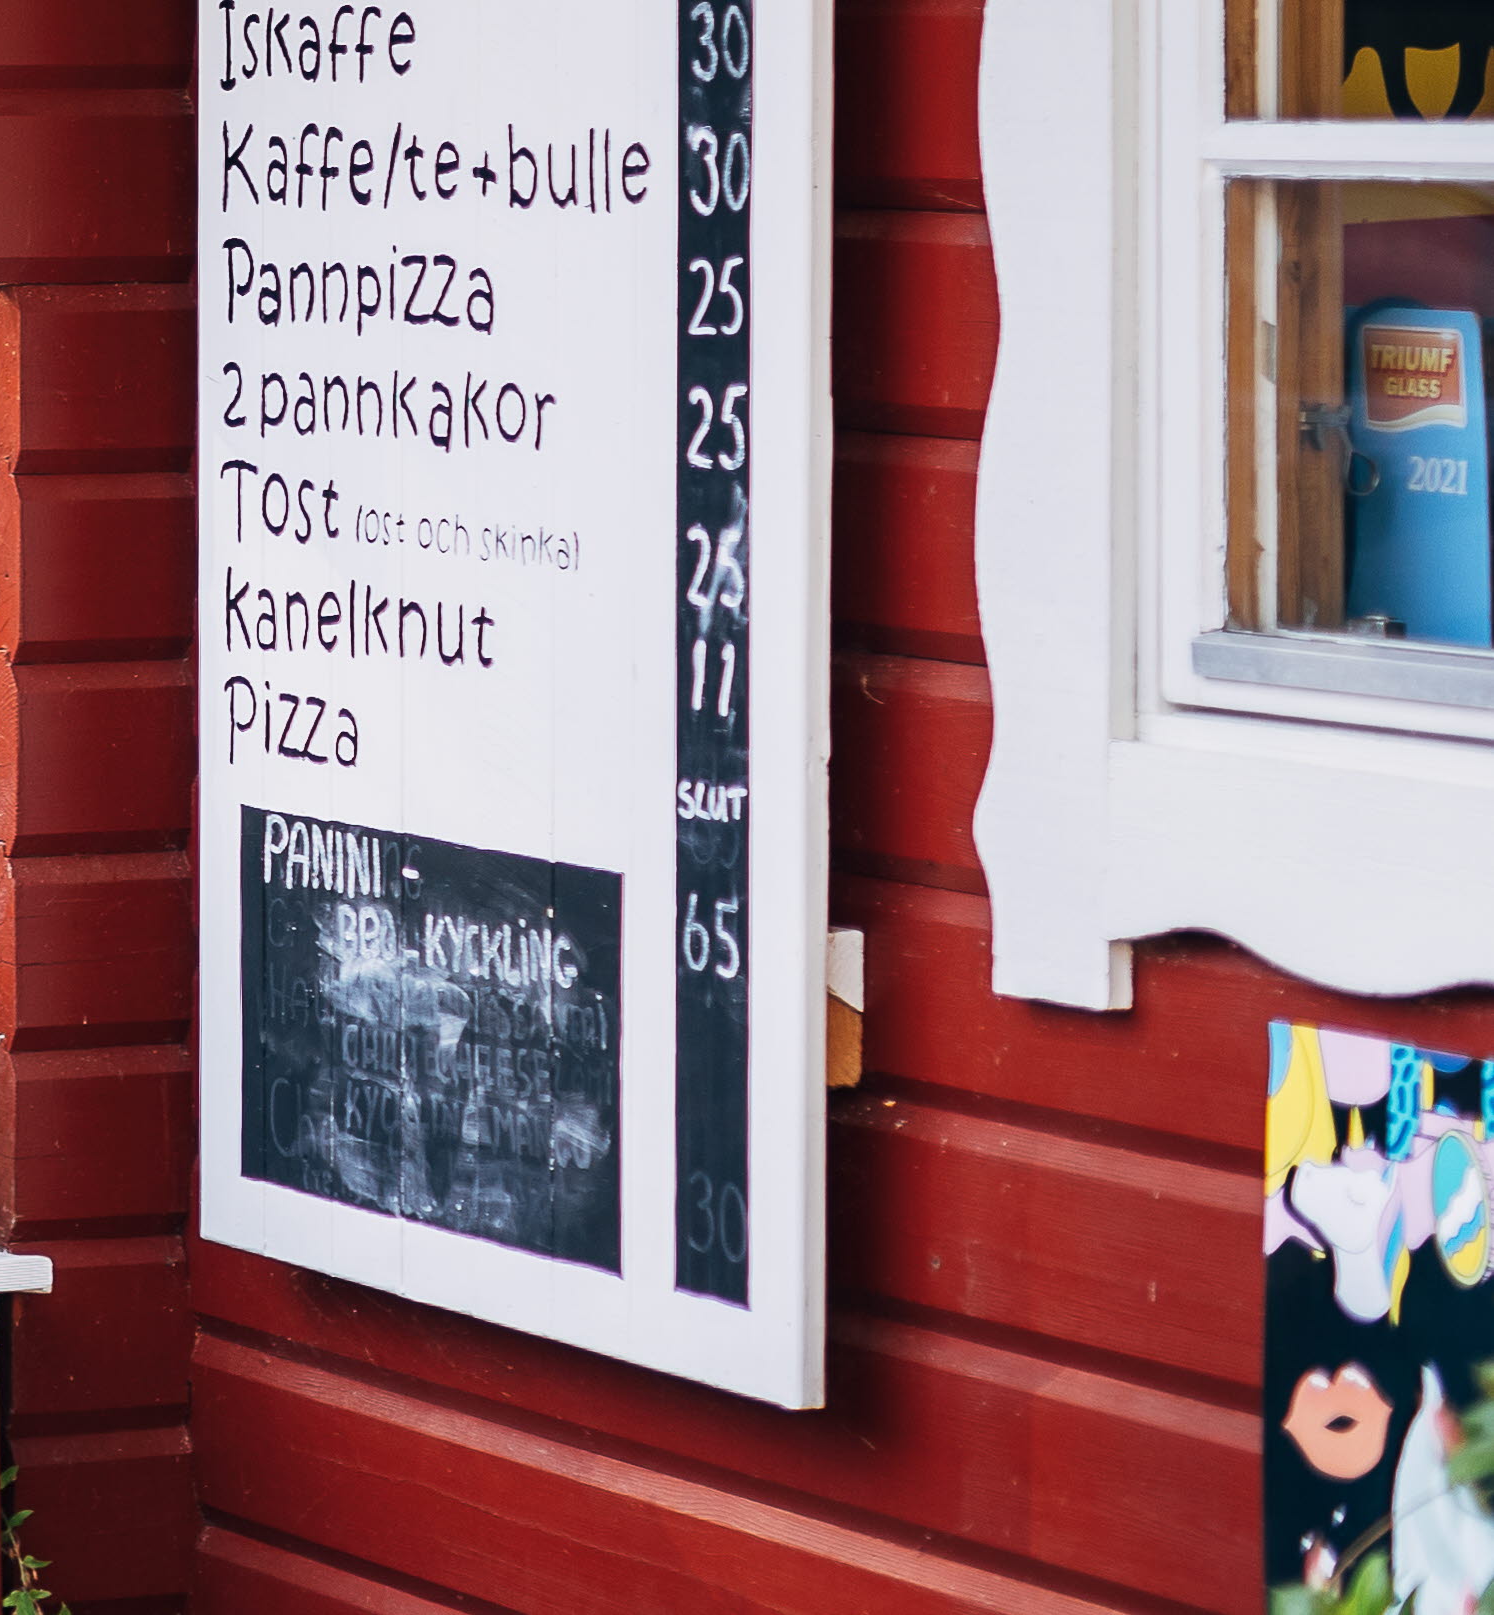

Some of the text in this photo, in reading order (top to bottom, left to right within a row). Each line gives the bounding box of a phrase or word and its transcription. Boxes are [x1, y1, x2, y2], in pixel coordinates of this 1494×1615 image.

[691, 1, 749, 82] 30
[221, 121, 652, 213] Kaffe/te+bulle
[688, 124, 751, 216] 30
[222, 237, 495, 336] Pannpizza
[687, 257, 744, 336] 25
[1370, 344, 1455, 373] TRIUMF
[1386, 377, 1442, 399] GLASS
[687, 385, 748, 470] 25
[220, 459, 340, 545] Tost
[417, 514, 471, 555] och
[1407, 455, 1469, 495] 2021
[686, 524, 746, 608] 25
[224, 675, 360, 767] Pizza
[677, 781, 749, 823] SLUT
[263, 814, 382, 899] PANINI
[683, 892, 740, 979] 65
